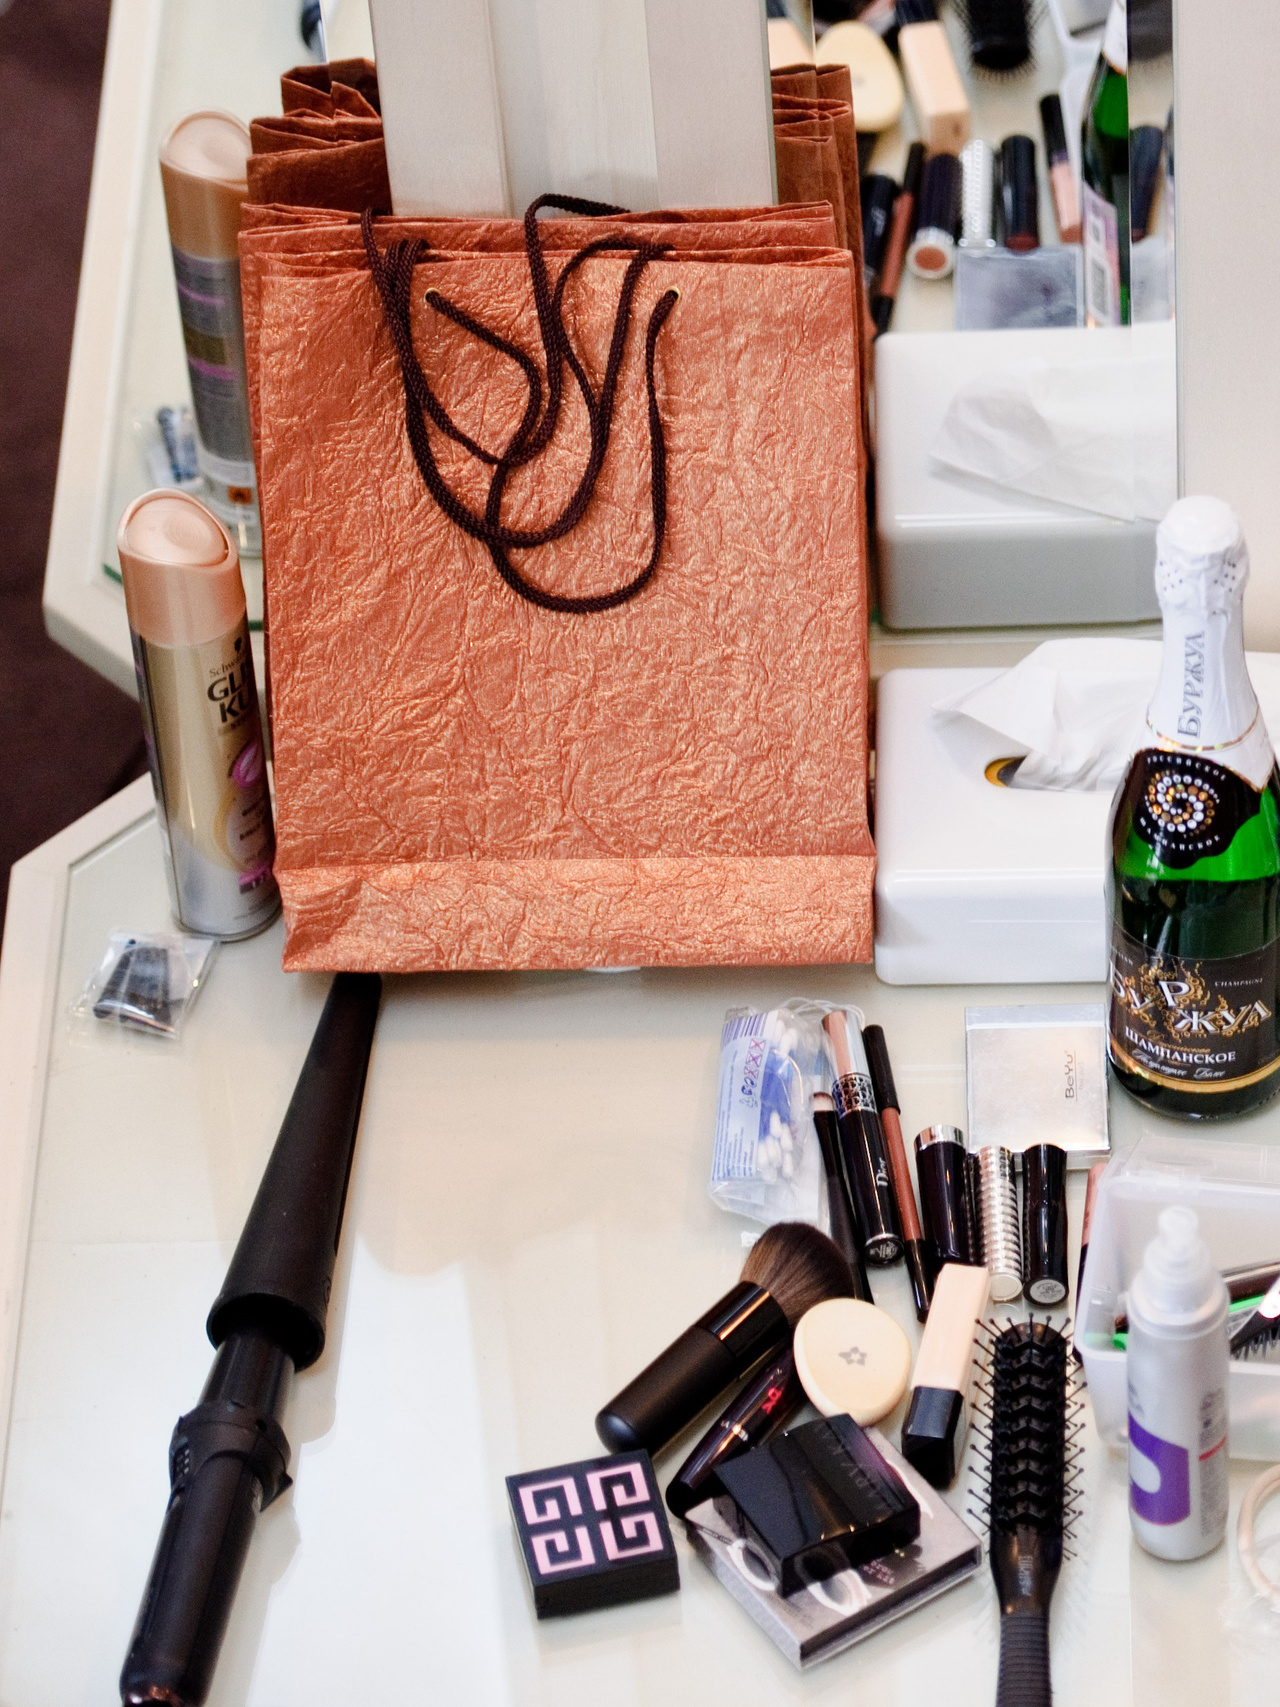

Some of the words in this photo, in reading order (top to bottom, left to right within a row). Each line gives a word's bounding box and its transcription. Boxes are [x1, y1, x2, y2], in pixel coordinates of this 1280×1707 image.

[1125, 1026, 1236, 1064] ШАМПАНСКОЕ
[1064, 1053, 1075, 1099] BeYu
[876, 1157, 888, 1187] Dior
